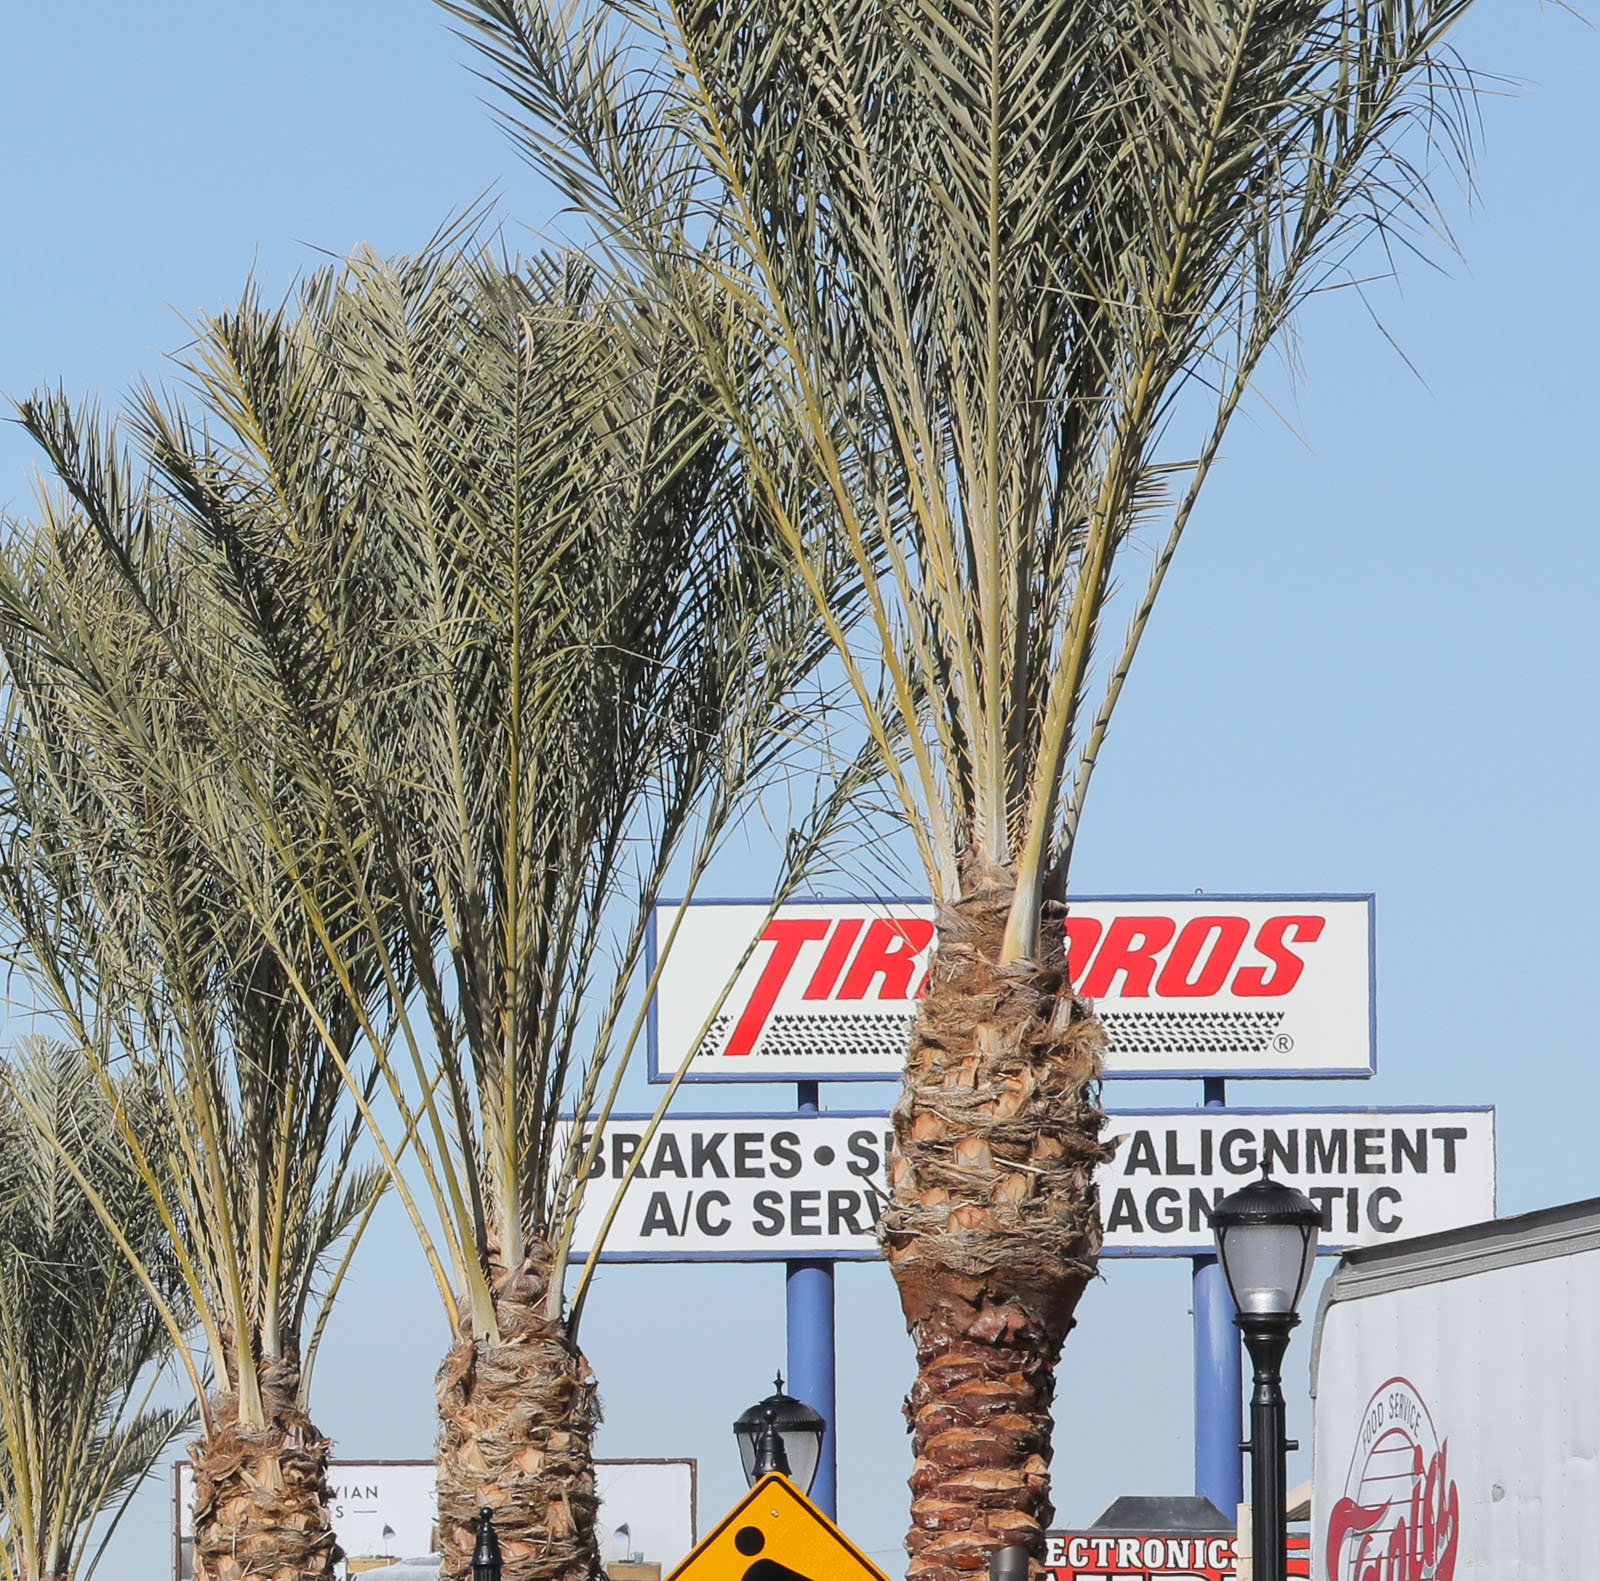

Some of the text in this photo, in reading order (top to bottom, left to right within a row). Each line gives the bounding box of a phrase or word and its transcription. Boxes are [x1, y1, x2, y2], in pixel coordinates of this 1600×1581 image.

[723, 918, 938, 1057] TIR
[1123, 1127, 1468, 1176] ALIGNMENT
[639, 1186, 1404, 1237] A/C SERV AGNTIC
[1362, 1392, 1422, 1457] FOOD SERVICE
[1045, 1536, 1238, 1570] ECTRONIC
